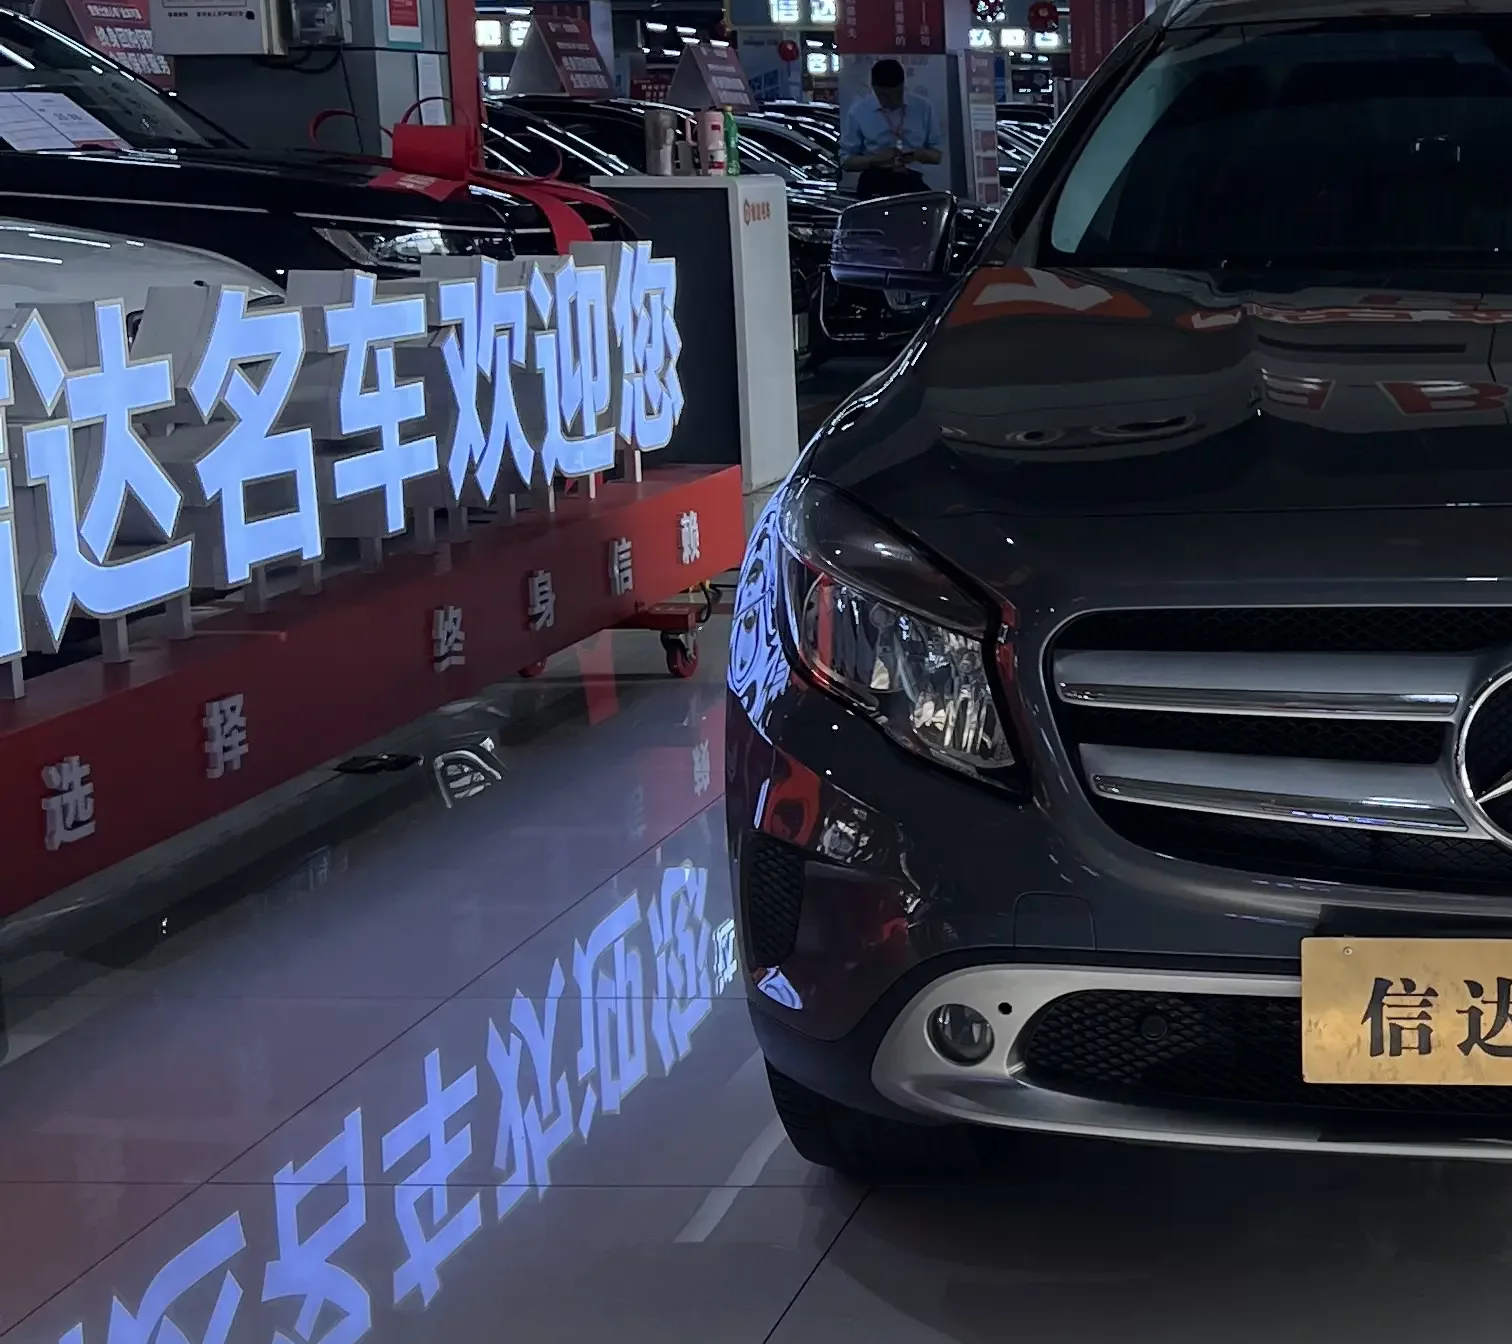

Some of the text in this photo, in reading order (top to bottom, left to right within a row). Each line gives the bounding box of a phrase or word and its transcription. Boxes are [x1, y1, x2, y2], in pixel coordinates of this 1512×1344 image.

[0, 241, 685, 659] 达名车欢迎您
